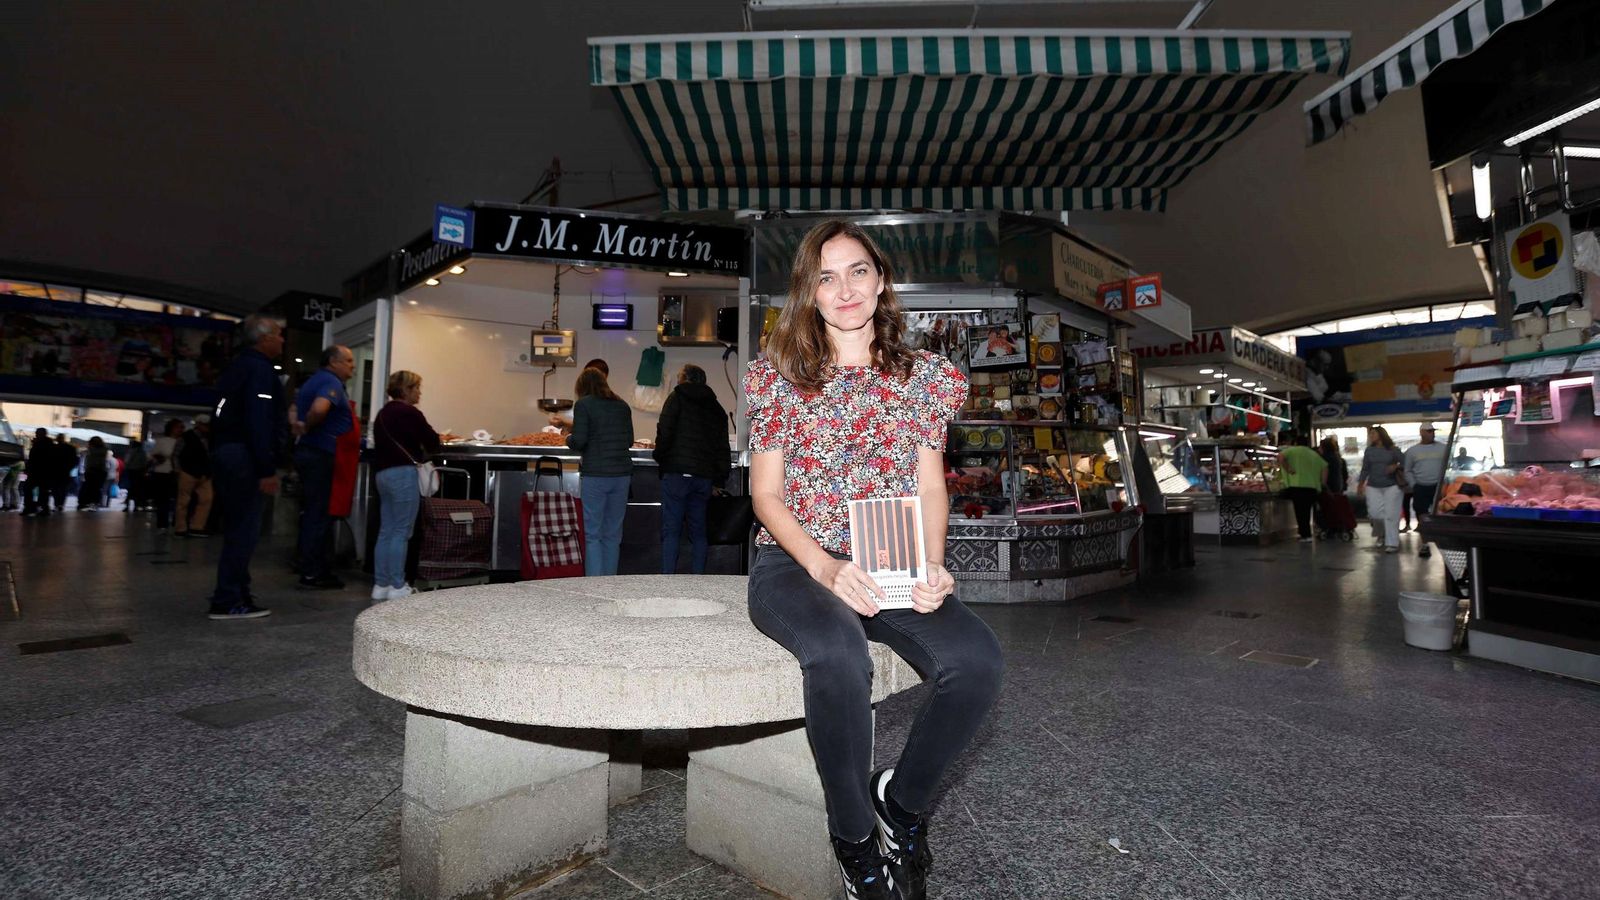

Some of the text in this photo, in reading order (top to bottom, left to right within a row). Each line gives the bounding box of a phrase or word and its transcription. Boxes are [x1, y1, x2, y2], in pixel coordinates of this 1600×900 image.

[495, 215, 712, 262] J.M. Martín
[725, 259, 738, 270] 115
[302, 303, 326, 321] La
